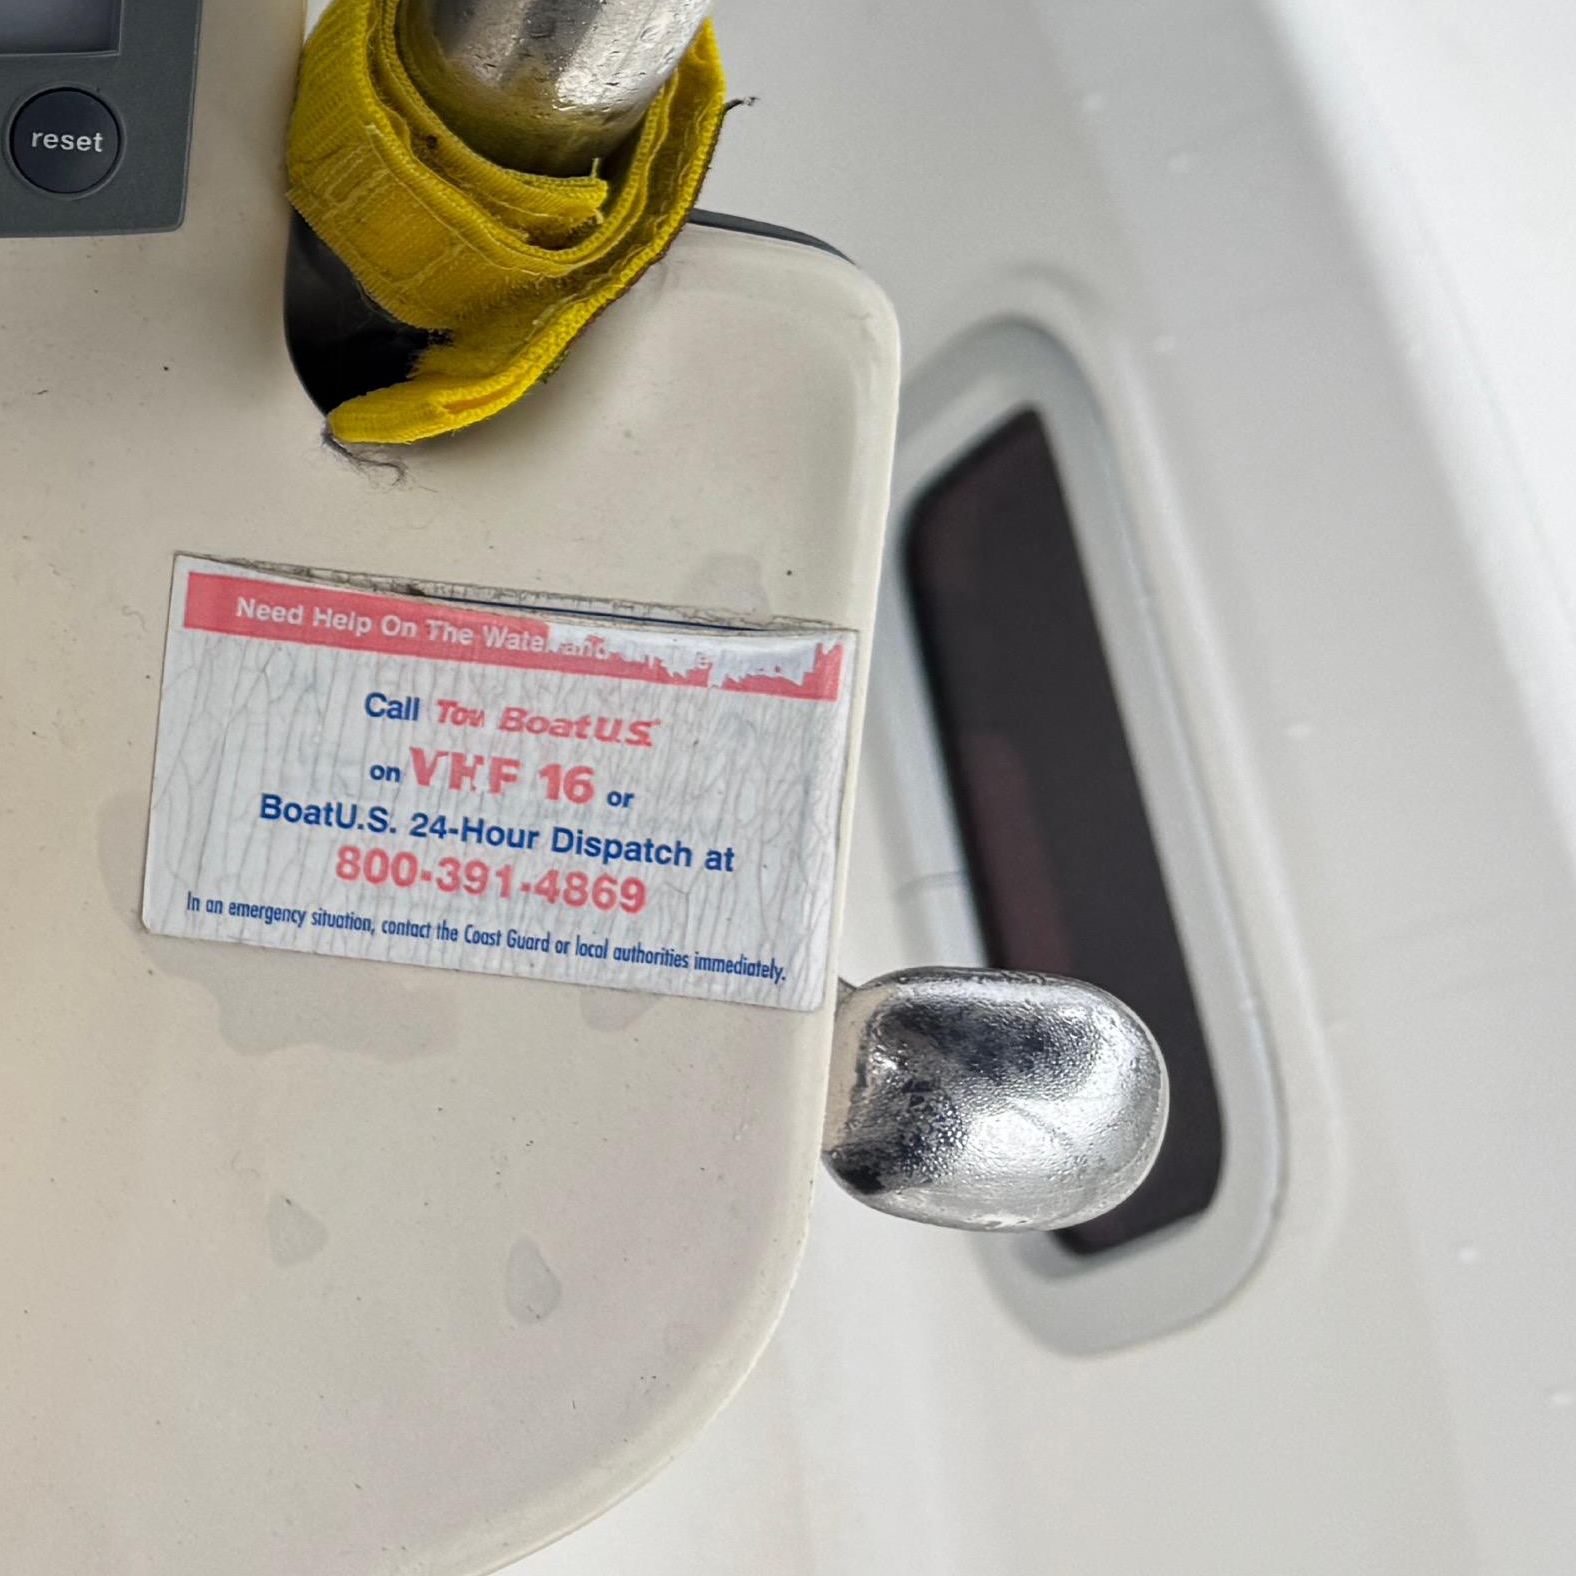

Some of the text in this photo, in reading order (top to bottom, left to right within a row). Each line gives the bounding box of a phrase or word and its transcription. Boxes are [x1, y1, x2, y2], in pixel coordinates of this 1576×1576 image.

[30, 126, 104, 154] reset
[236, 597, 304, 625] Need
[312, 606, 373, 637] Help
[380, 615, 418, 638] On
[425, 619, 473, 645] The
[483, 625, 551, 654] Wate
[364, 692, 420, 722] Call
[369, 746, 635, 809] on VHF 16 or
[259, 793, 735, 872] BoatU.S. 24-Hour Dispatch at
[335, 845, 647, 914] 800-391-4869
[187, 891, 786, 985] In an emergency situation, contact the Coast Guard or local authorities immediately.
